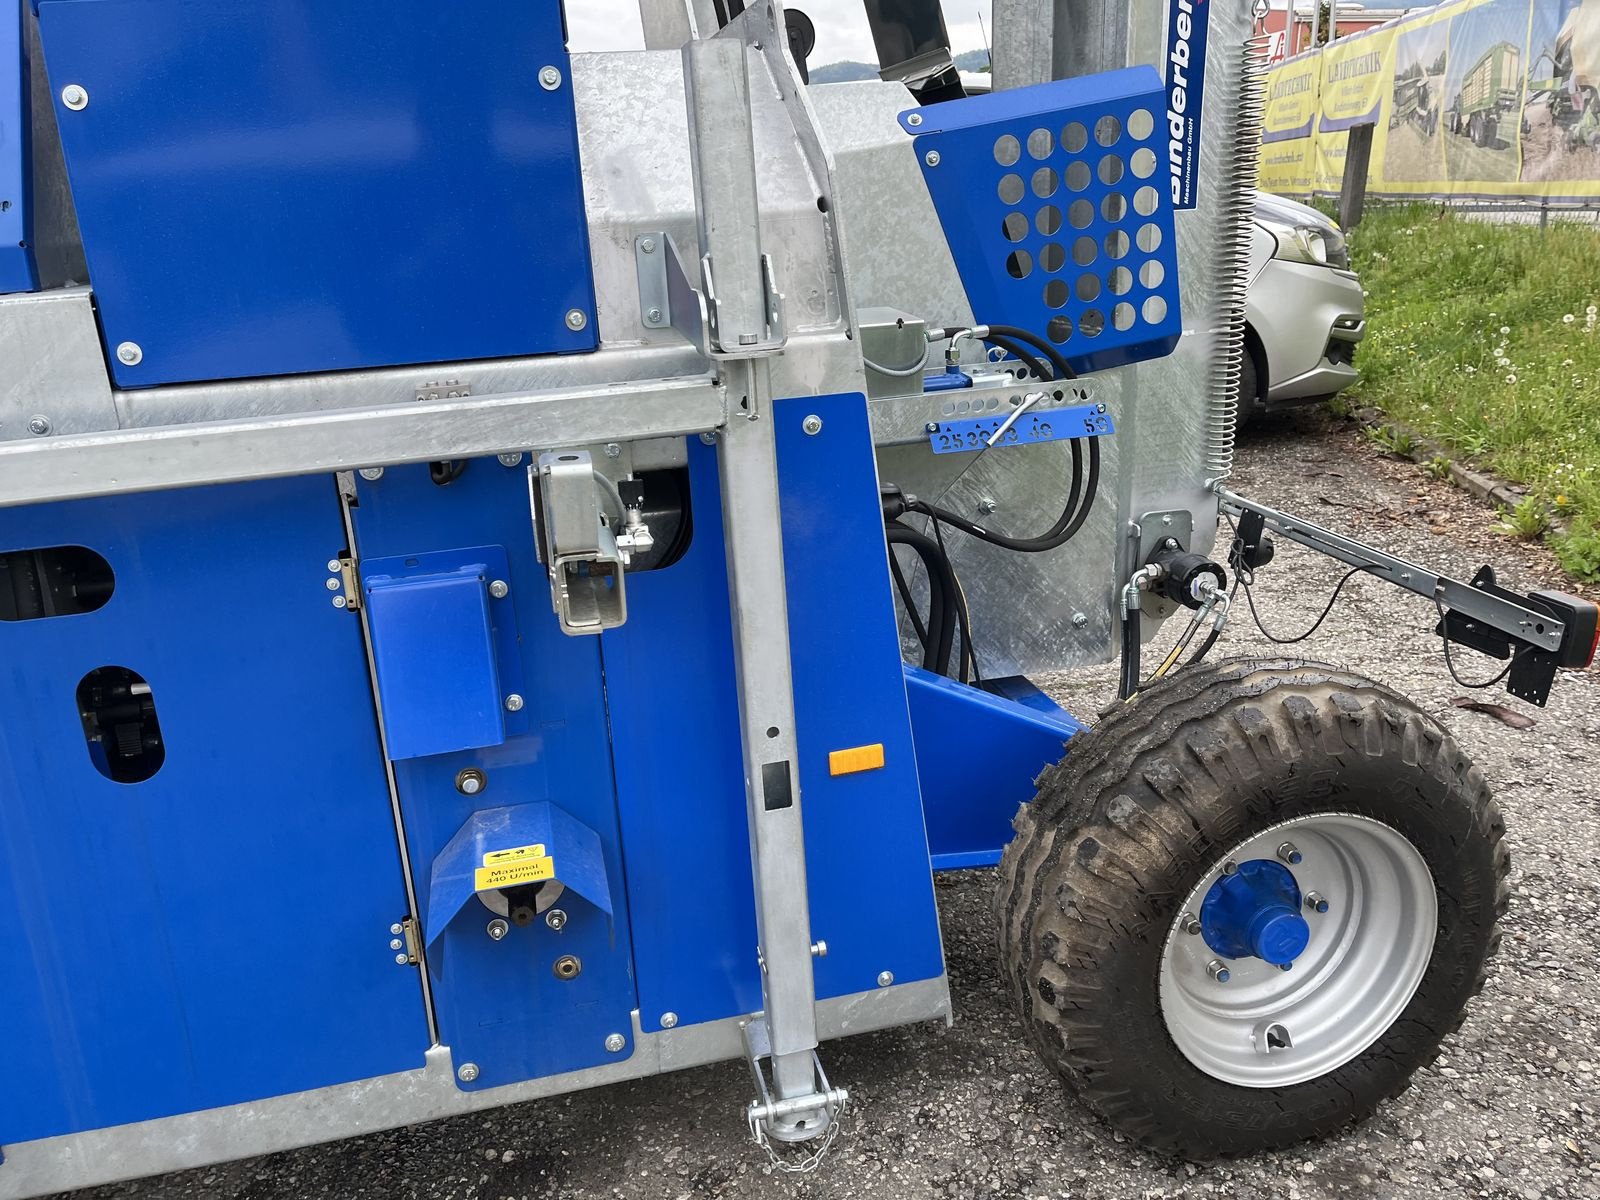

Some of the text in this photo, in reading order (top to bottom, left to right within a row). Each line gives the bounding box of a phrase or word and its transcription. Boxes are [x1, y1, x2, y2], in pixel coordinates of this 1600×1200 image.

[1183, 147, 1192, 205] Maschinenbau
[938, 433, 964, 450] 25
[1083, 416, 1109, 433] 50
[491, 863, 539, 876] Maximal
[510, 870, 544, 879] U/min
